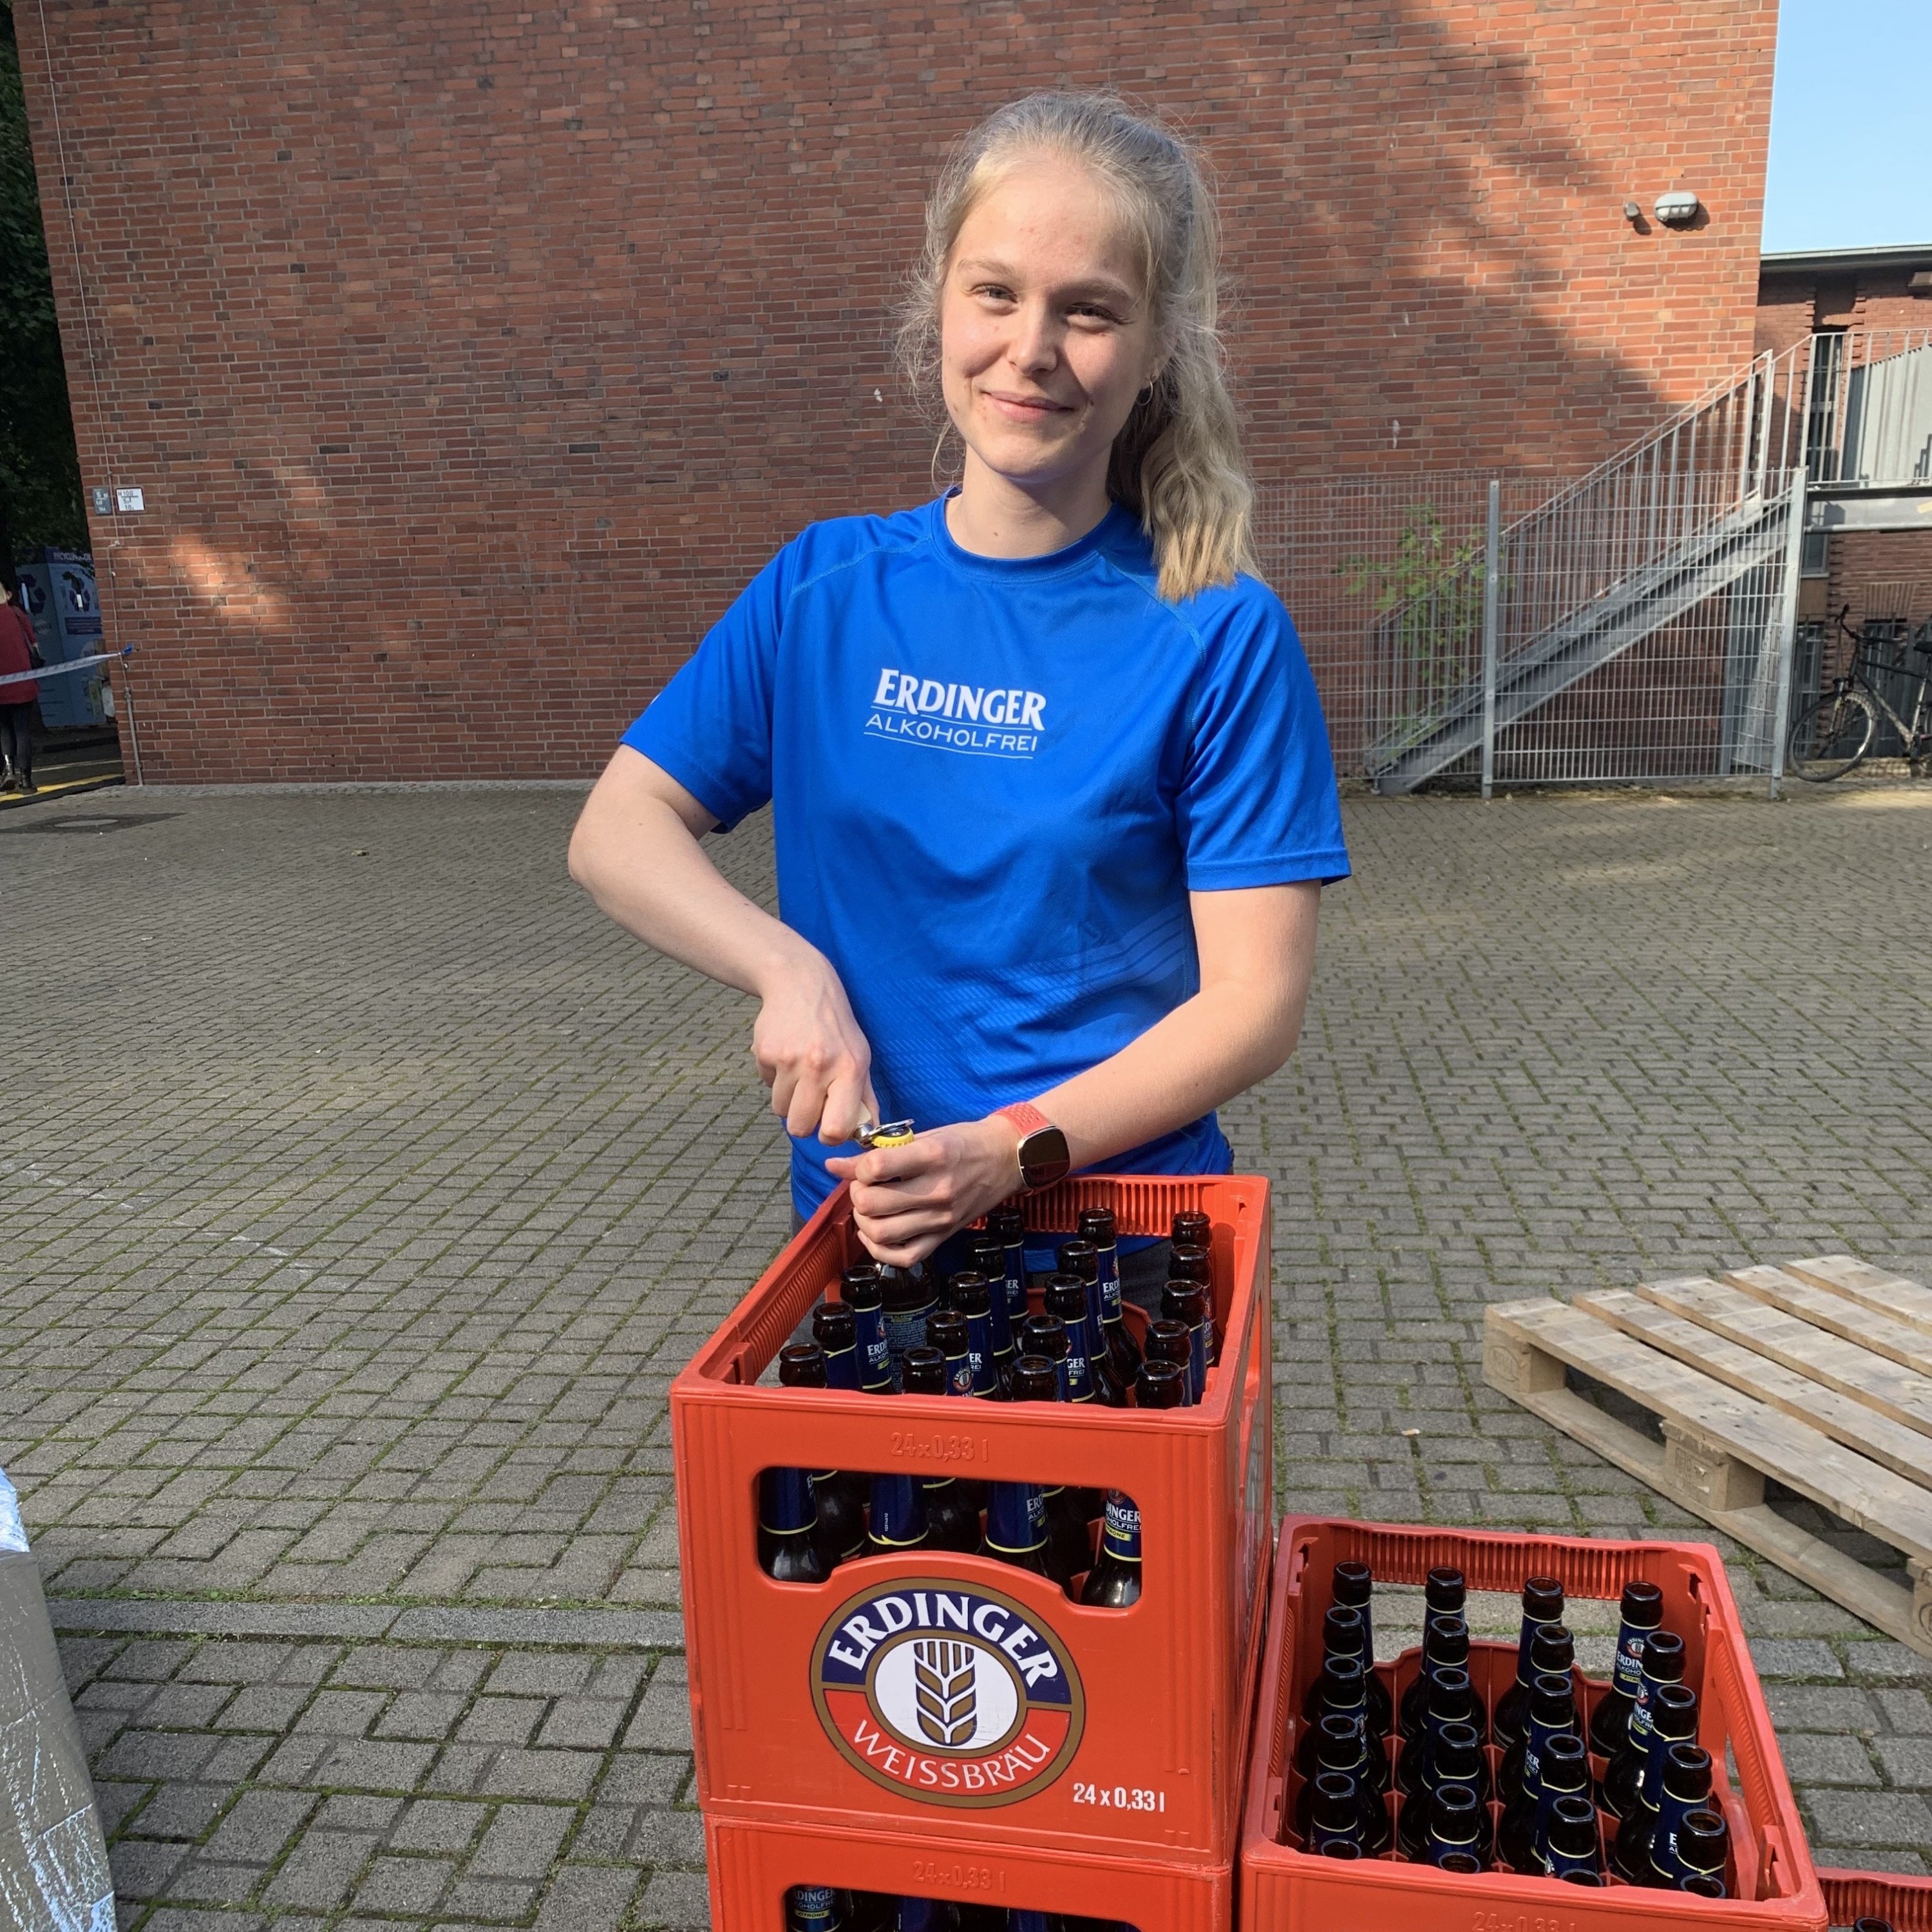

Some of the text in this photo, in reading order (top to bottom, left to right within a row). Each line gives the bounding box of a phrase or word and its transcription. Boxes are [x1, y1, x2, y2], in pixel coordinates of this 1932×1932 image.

[873, 668, 1046, 731] ERDINGER
[866, 713, 1037, 752] ALKOHOLFREI
[1106, 1500, 1141, 1524] DINGER
[828, 1593, 1059, 1688] ERDINGER
[1616, 1651, 1643, 1669] ERDIN
[853, 1719, 1051, 1790] WEISSBRÄU
